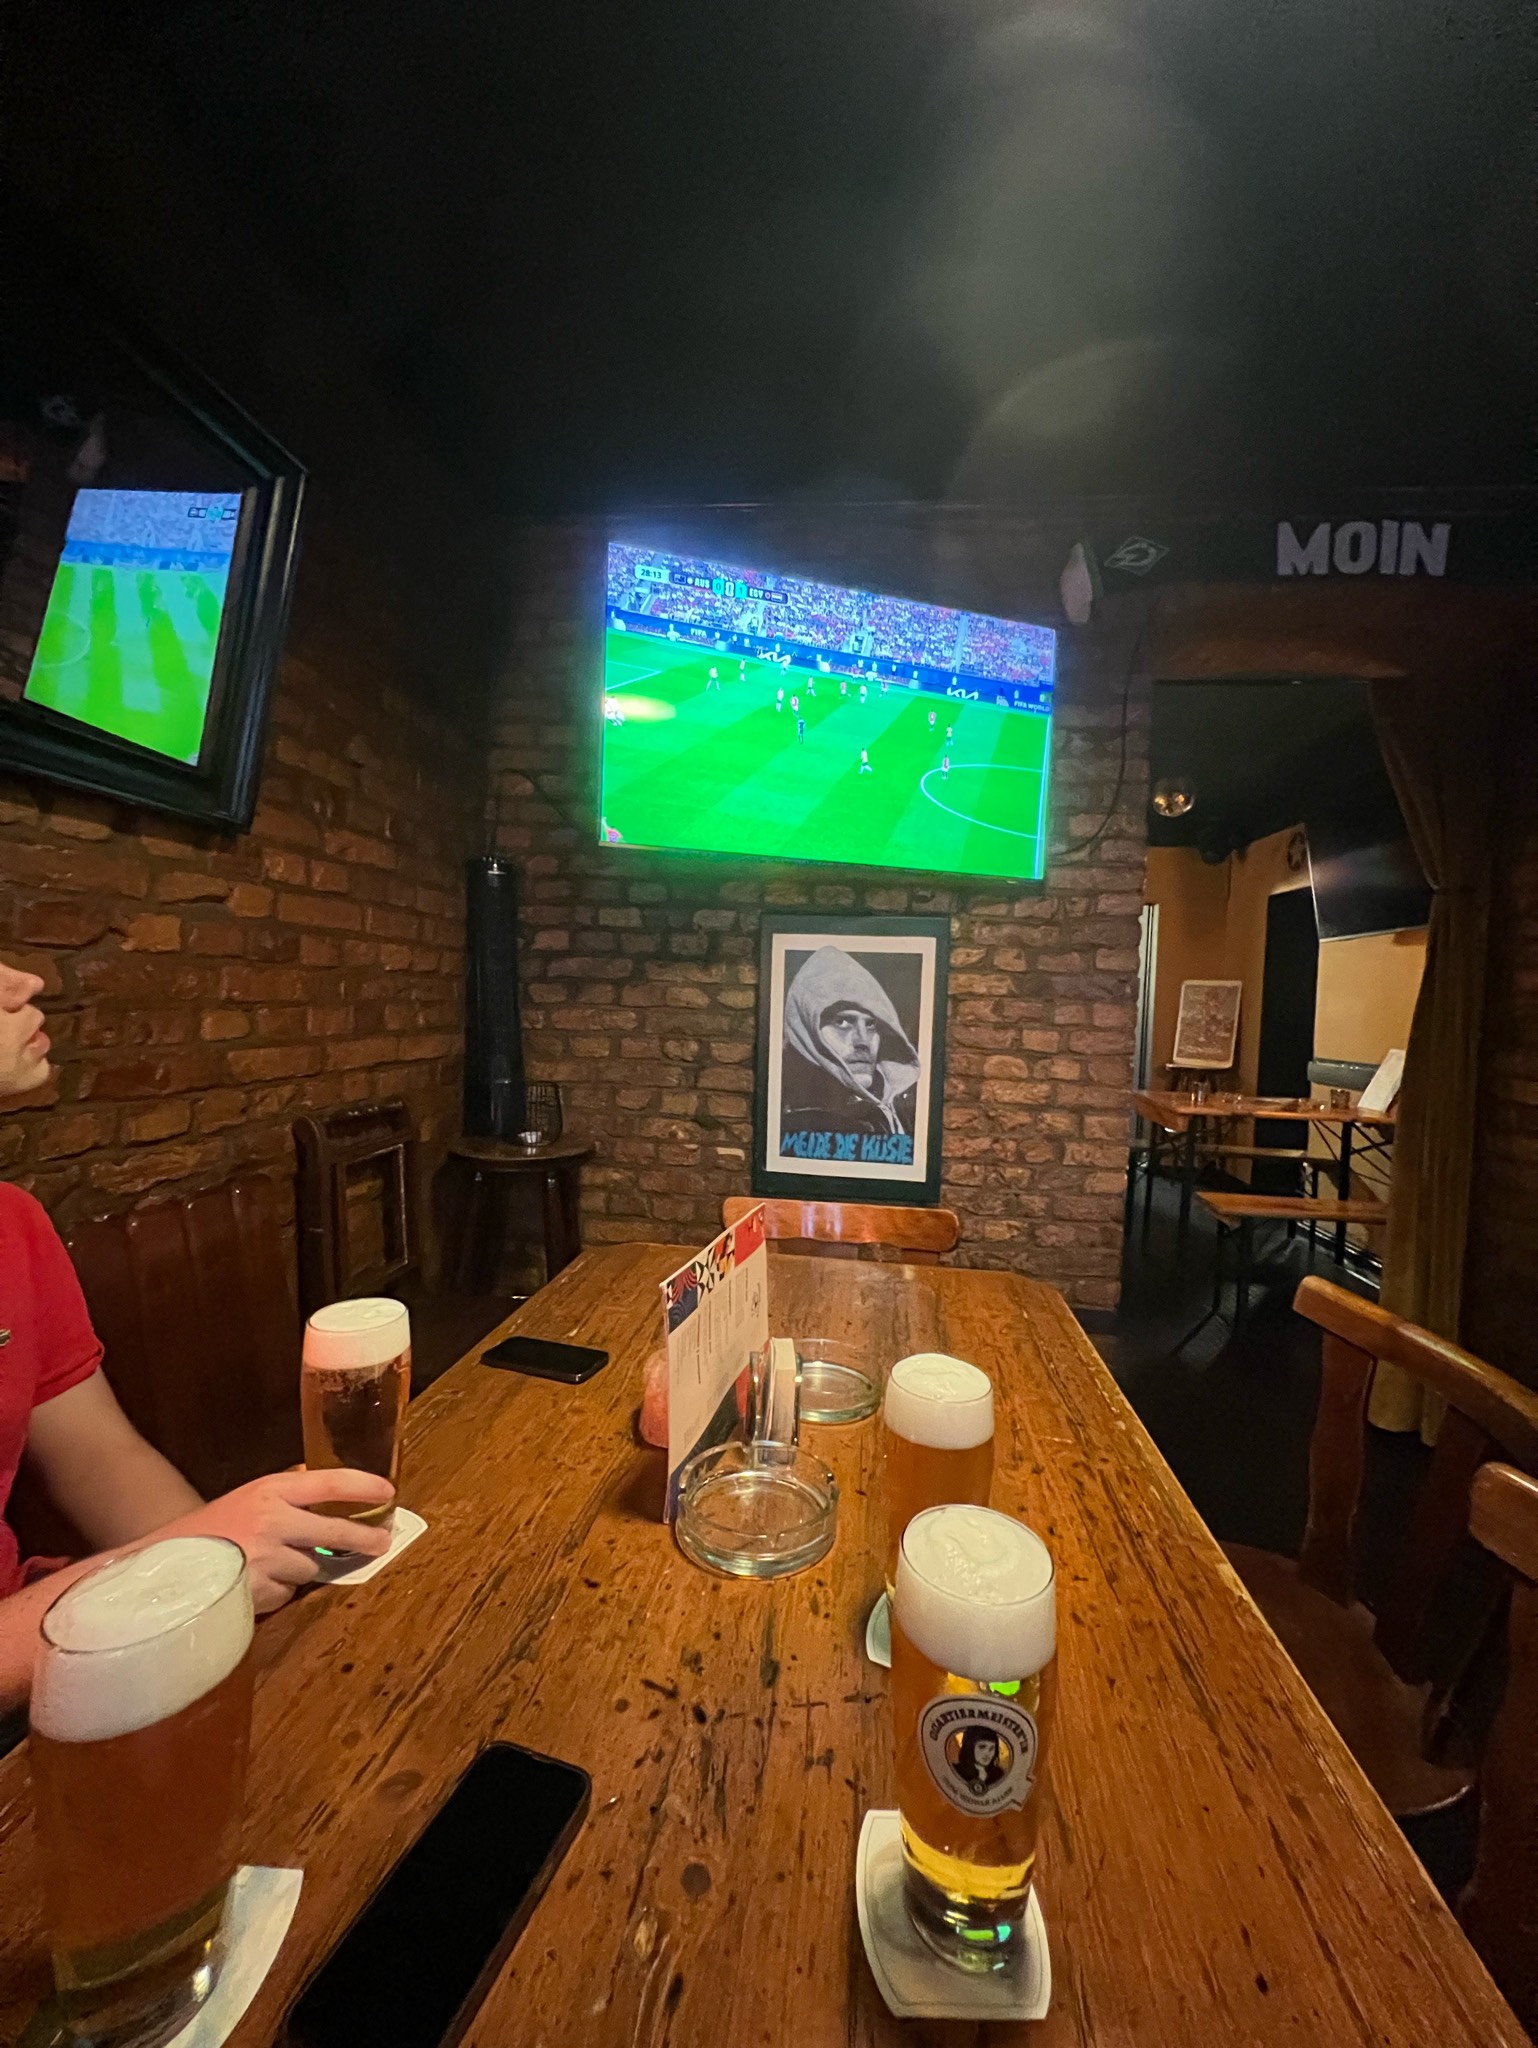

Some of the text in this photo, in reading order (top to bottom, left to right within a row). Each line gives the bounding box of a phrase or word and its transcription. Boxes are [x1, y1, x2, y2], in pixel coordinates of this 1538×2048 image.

[1277, 519, 1452, 577] MOIN
[640, 568, 662, 580] 28:13
[694, 577, 710, 589] AUS
